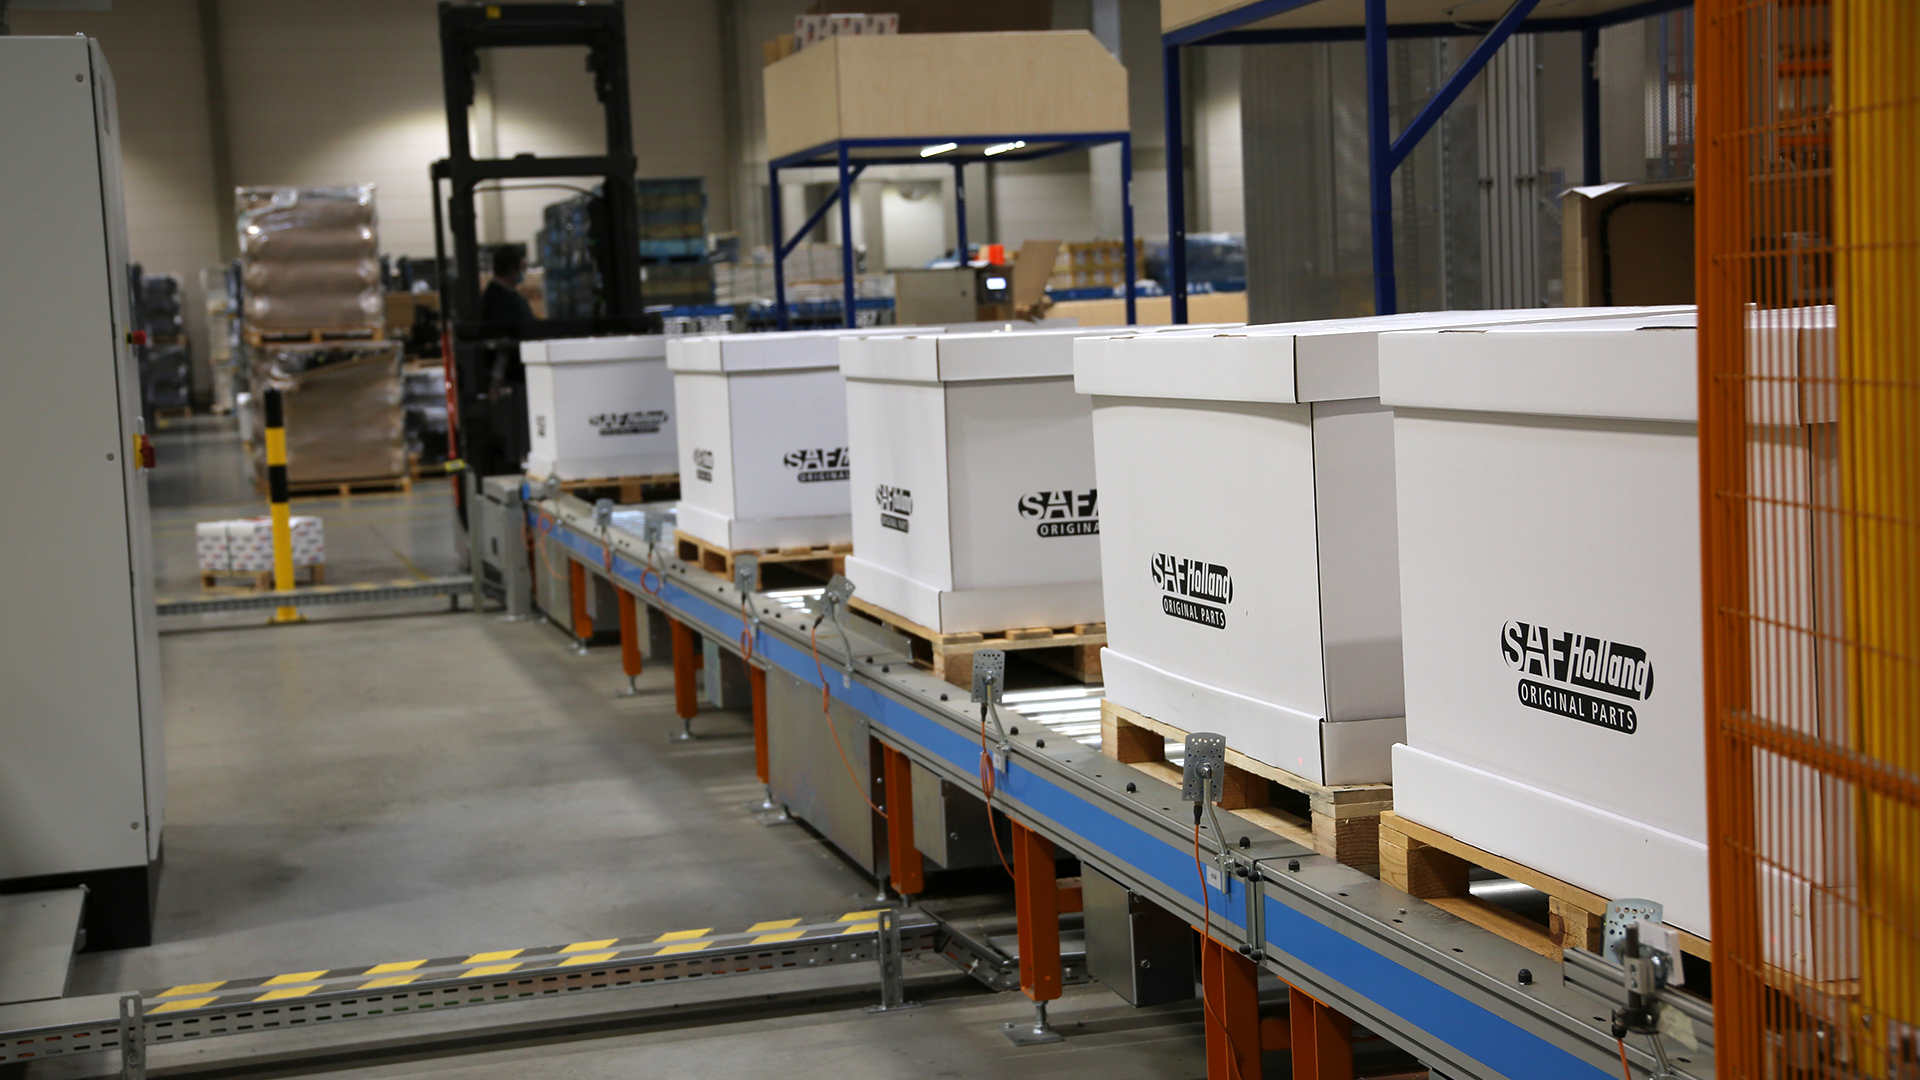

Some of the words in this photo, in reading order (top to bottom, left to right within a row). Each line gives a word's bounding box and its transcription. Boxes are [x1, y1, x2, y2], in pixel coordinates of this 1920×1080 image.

[783, 448, 837, 470] SAF
[1018, 489, 1090, 519] SAF
[1040, 523, 1099, 536] ORIGINA
[1151, 551, 1186, 594] SAF
[1186, 558, 1232, 605] Holland
[1164, 598, 1198, 620] ORIGINAL
[1201, 607, 1225, 627] PARTS
[1501, 620, 1565, 682] SAF
[1564, 632, 1653, 701] Holland
[1520, 683, 1585, 717] ORIGINAL
[1591, 701, 1635, 731] PARTS
